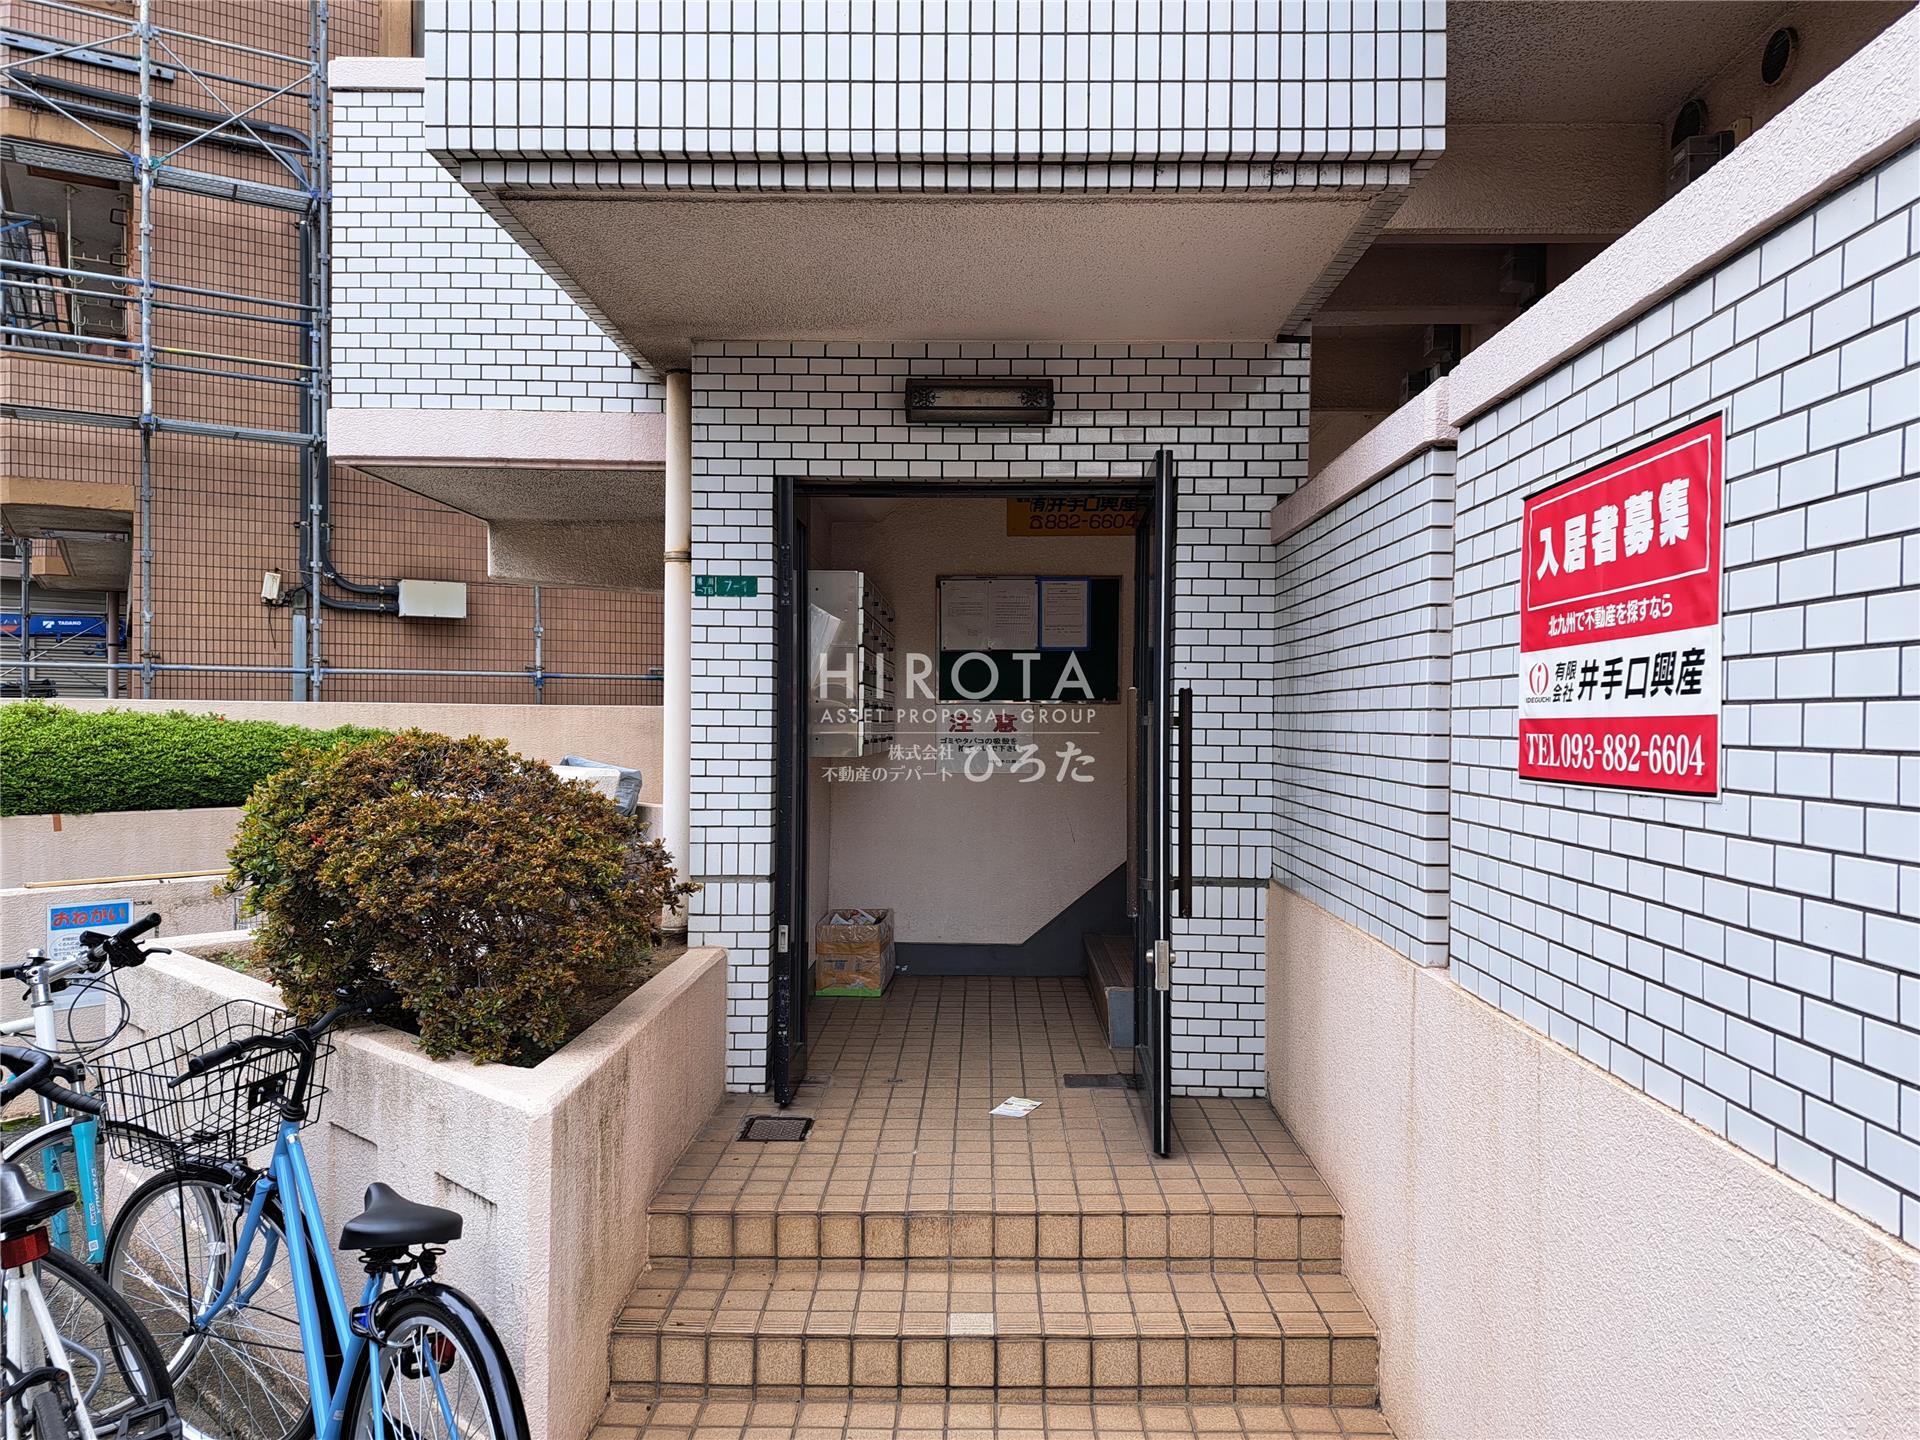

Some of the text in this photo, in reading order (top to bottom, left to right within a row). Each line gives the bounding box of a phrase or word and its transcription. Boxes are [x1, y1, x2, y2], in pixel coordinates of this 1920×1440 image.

[1536, 477, 1691, 581] 入居者募集
[724, 580, 747, 593] 7-1
[1548, 593, 1673, 637] 北九州で不動産を探すなら
[1555, 660, 1577, 681] 有限
[1577, 647, 1706, 701] 井手口興産
[1526, 696, 1551, 704] IDEGUCHI
[1552, 683, 1575, 702] 会社
[52, 908, 126, 928] おねがい
